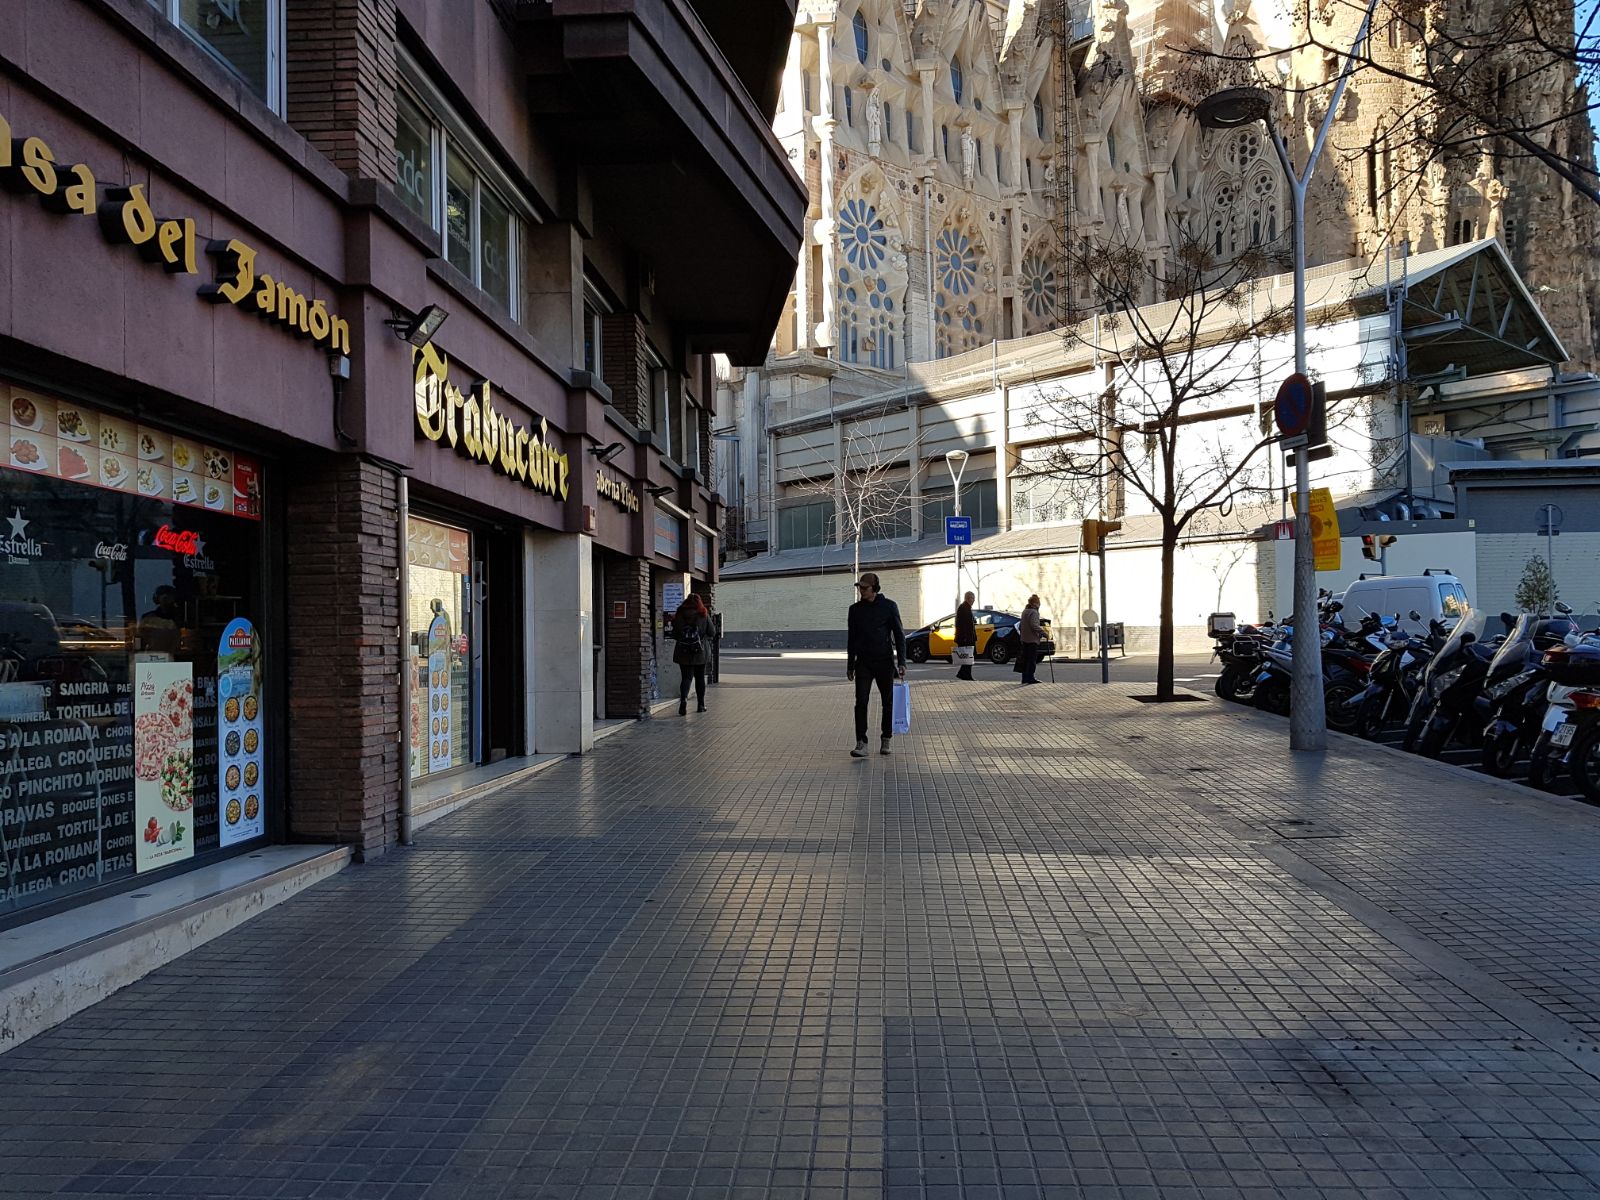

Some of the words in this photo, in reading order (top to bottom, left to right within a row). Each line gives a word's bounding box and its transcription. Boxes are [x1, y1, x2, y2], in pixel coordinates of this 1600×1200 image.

[0, 113, 97, 214] sa
[122, 184, 198, 274] del
[411, 341, 570, 503] Trabucaire
[597, 469, 620, 501] aberna
[59, 681, 110, 696] SANGRIA
[10, 711, 51, 724] ARINERA
[56, 702, 111, 720] TORTILLA
[113, 702, 129, 715] DE
[9, 732, 21, 749] A
[23, 731, 41, 747] LA
[44, 725, 100, 745] ROMANA
[58, 744, 132, 767] CROQUETAS
[18, 773, 83, 797] PINCHITO
[62, 794, 126, 815] BOQUERONES
[4, 832, 52, 851] MARINERA
[57, 815, 112, 839] TORTILLA
[114, 811, 129, 826] DE
[11, 858, 22, 875] A
[24, 853, 42, 871] LA
[45, 839, 99, 866] ROMANA
[59, 852, 133, 886] CROQUETAS
